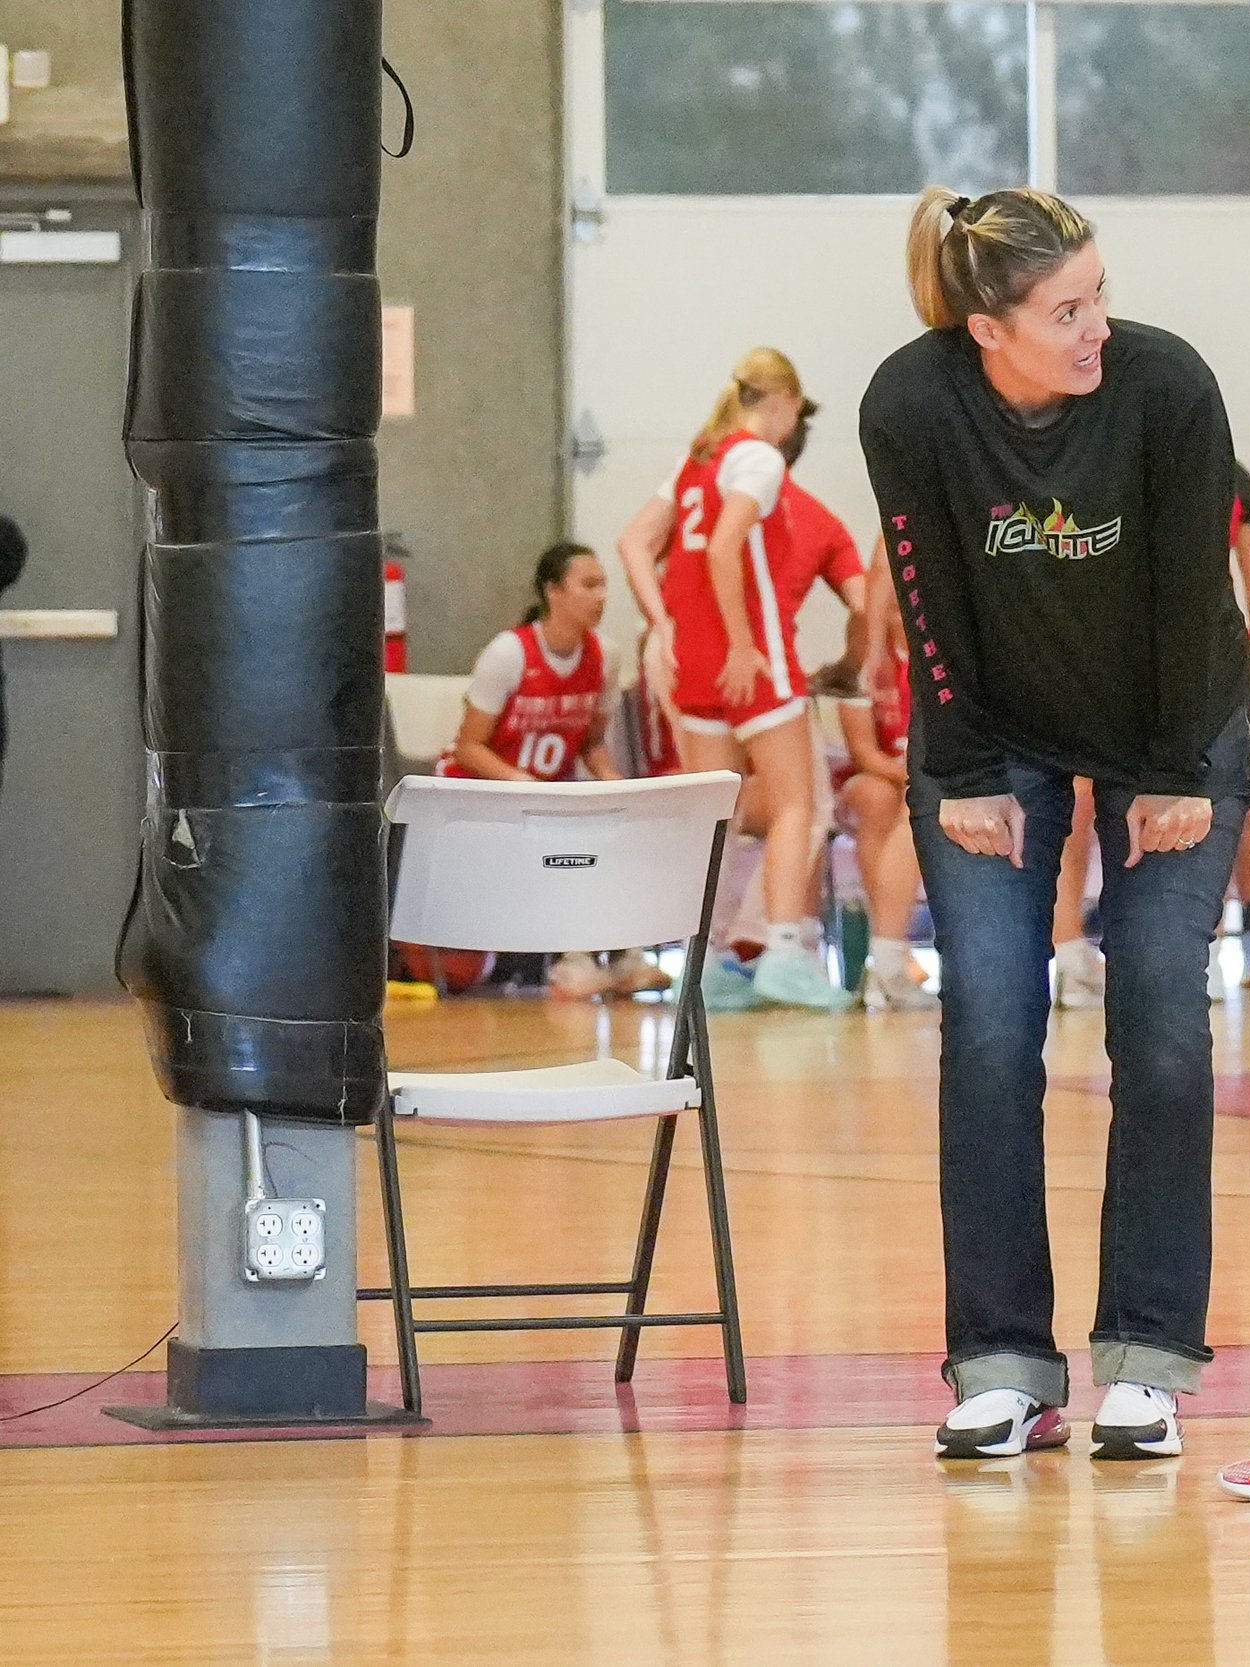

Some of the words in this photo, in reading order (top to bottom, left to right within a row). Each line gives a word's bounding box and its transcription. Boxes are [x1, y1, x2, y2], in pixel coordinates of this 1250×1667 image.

[681, 485, 708, 550] 2
[517, 731, 567, 775] 10
[549, 857, 592, 866] LIFETIME
